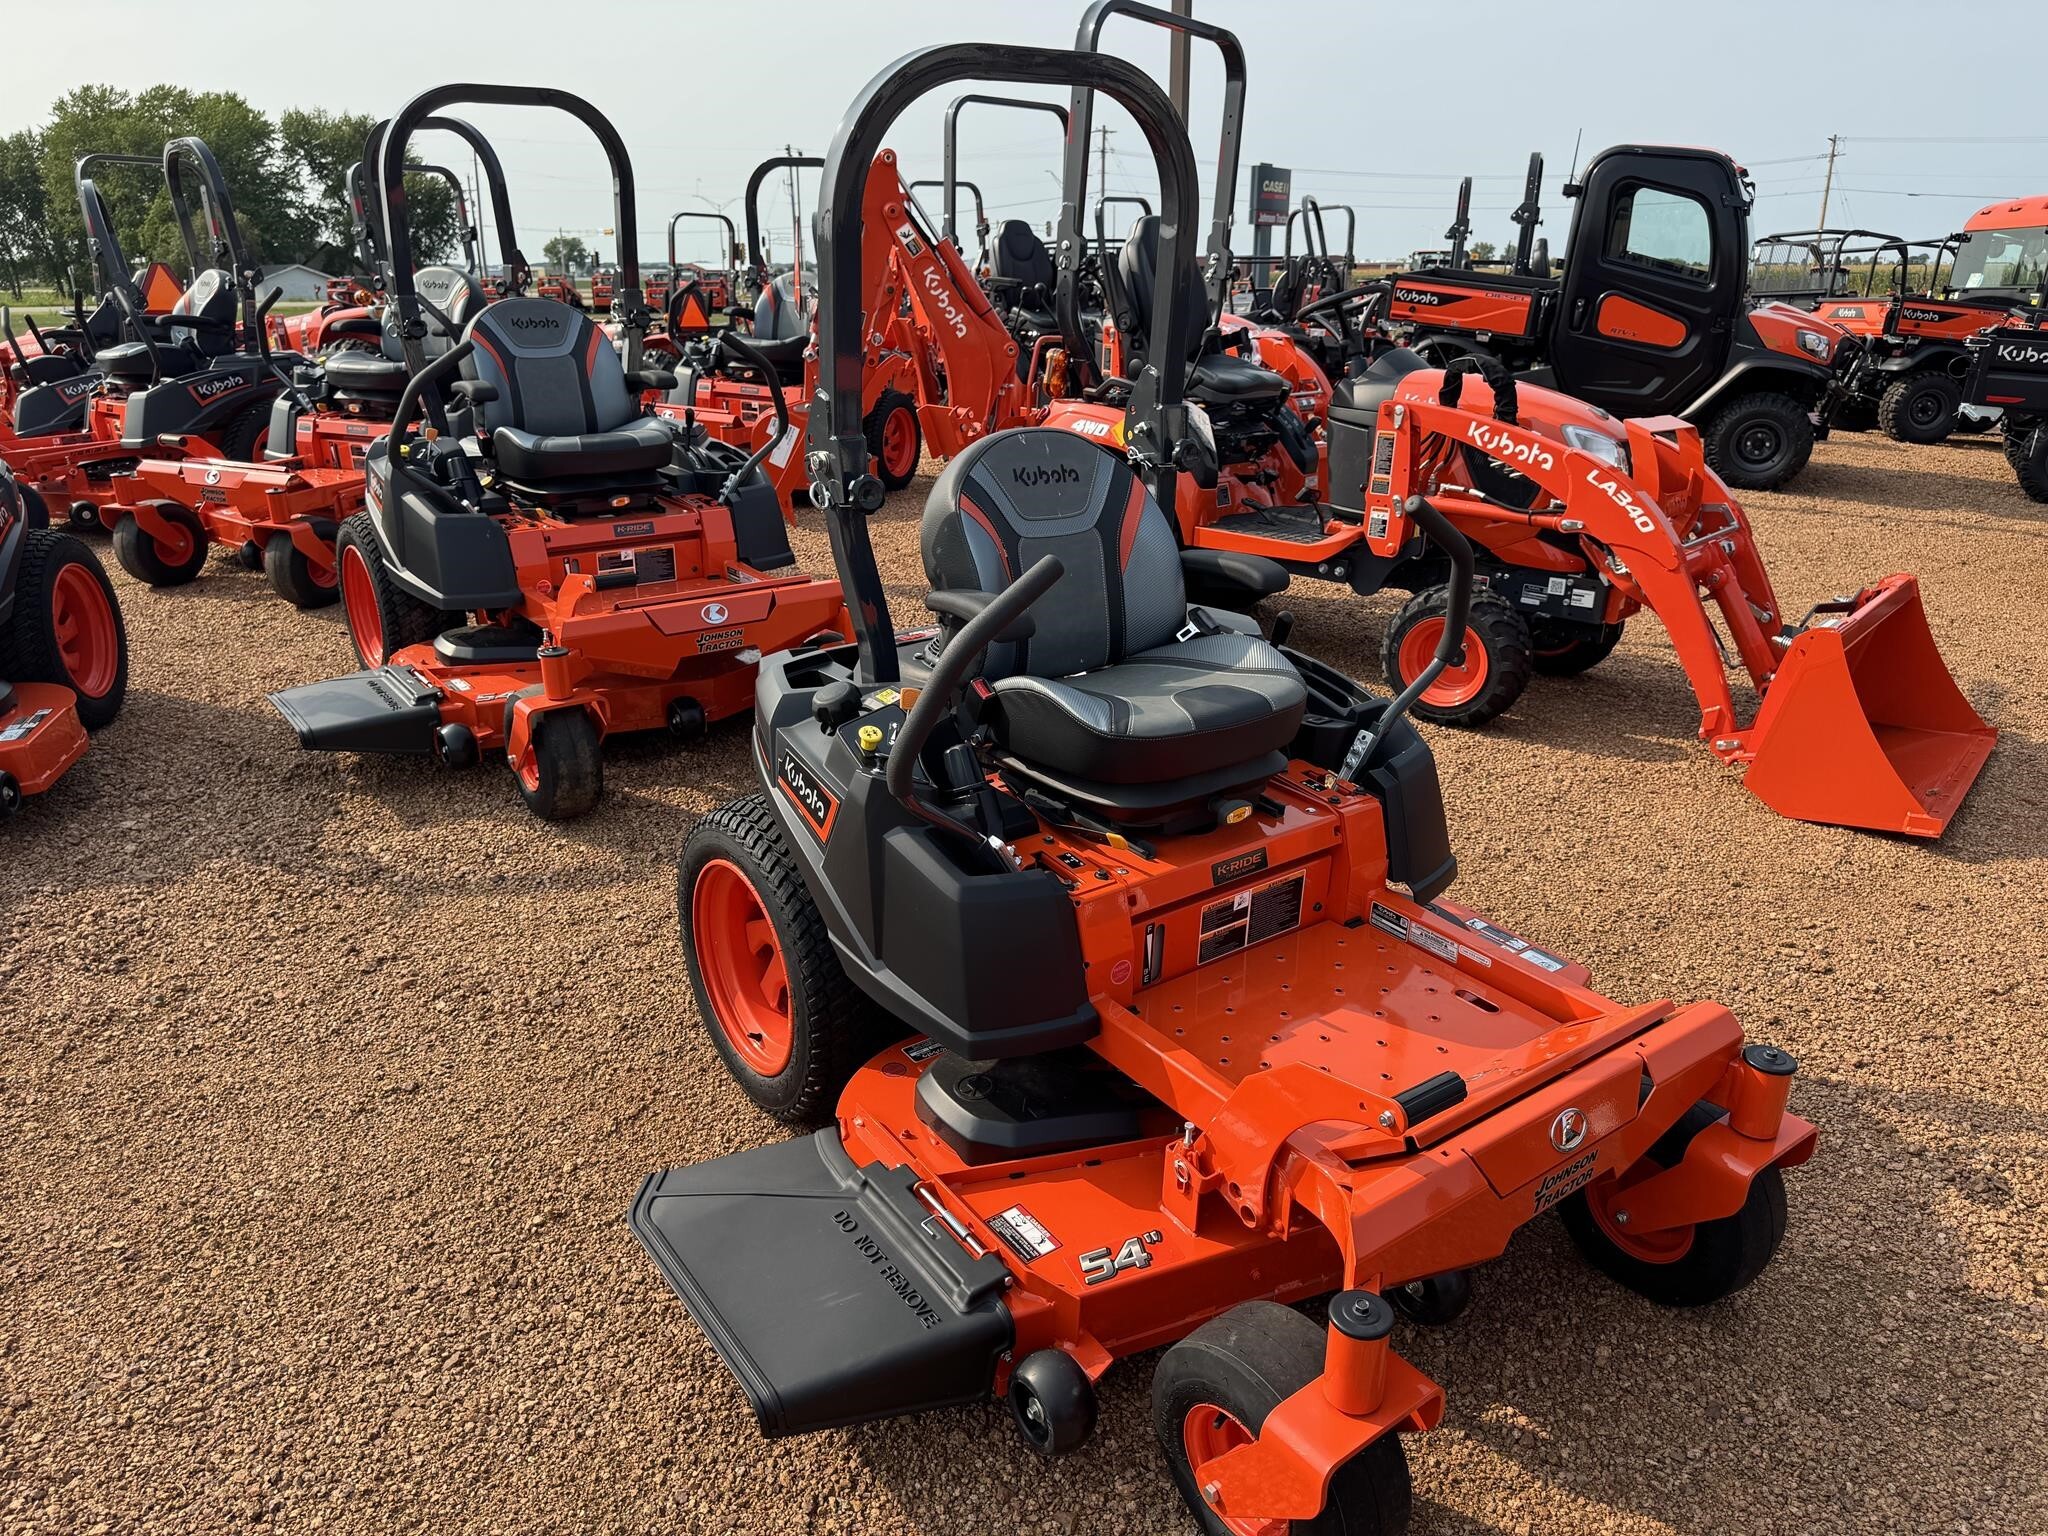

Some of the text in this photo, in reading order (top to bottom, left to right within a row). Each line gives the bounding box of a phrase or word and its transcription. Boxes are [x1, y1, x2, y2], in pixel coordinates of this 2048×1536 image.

[1263, 181, 1283, 192] CASE
[423, 279, 449, 289] Kubota
[923, 266, 967, 338] Kubota
[1396, 289, 1438, 305] Kubota
[511, 315, 560, 329] Kubota
[1903, 309, 1939, 321] Kubota
[65, 378, 100, 396] Kubot
[198, 375, 244, 395] Kubota
[1071, 419, 1110, 437] 4WD
[1467, 420, 1554, 471] Kubota
[1012, 464, 1080, 487] Kubota
[1586, 469, 1656, 534] LA340
[696, 629, 744, 643] JOHNSON
[697, 639, 744, 653] TRACTOR
[784, 756, 825, 819] Kubota
[1217, 852, 1263, 876] K-RIDE
[1535, 1149, 1599, 1197] JOHNSON
[1534, 1167, 1594, 1214] TRACTOR
[831, 1208, 942, 1329] DO NOT REMOVE
[1079, 1230, 1163, 1286] 54"
